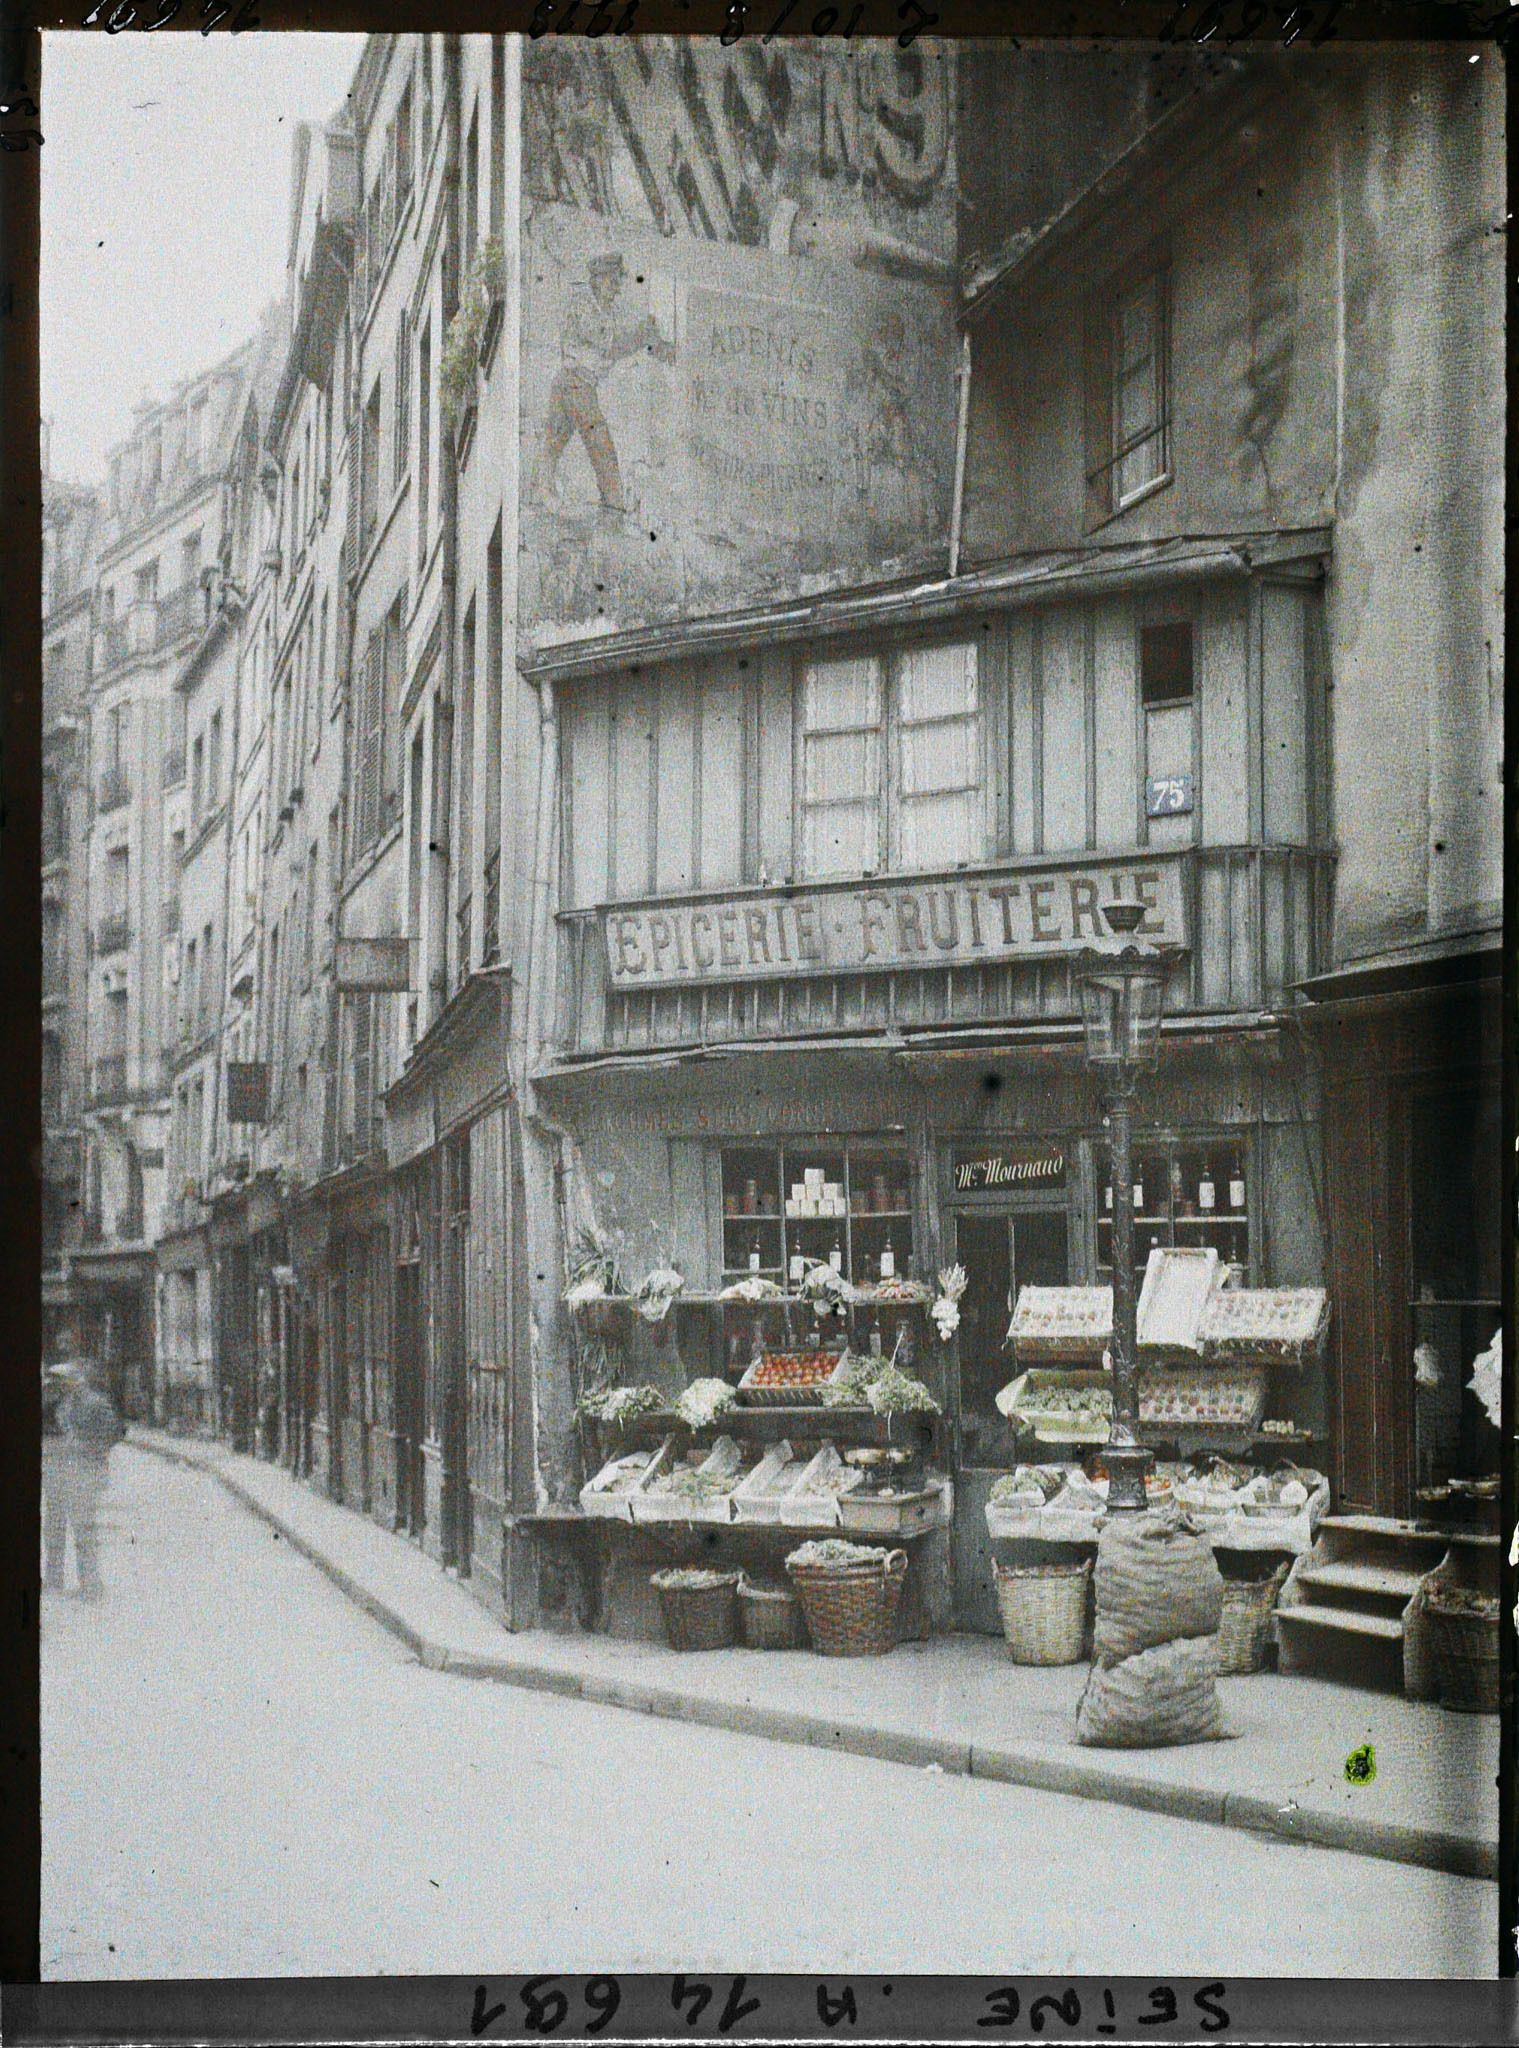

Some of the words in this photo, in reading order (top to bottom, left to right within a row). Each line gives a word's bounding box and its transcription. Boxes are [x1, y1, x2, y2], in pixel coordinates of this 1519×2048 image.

[1153, 780, 1185, 812] 75
[610, 902, 821, 976] EPICERIE
[671, 1975, 761, 2035] 14
